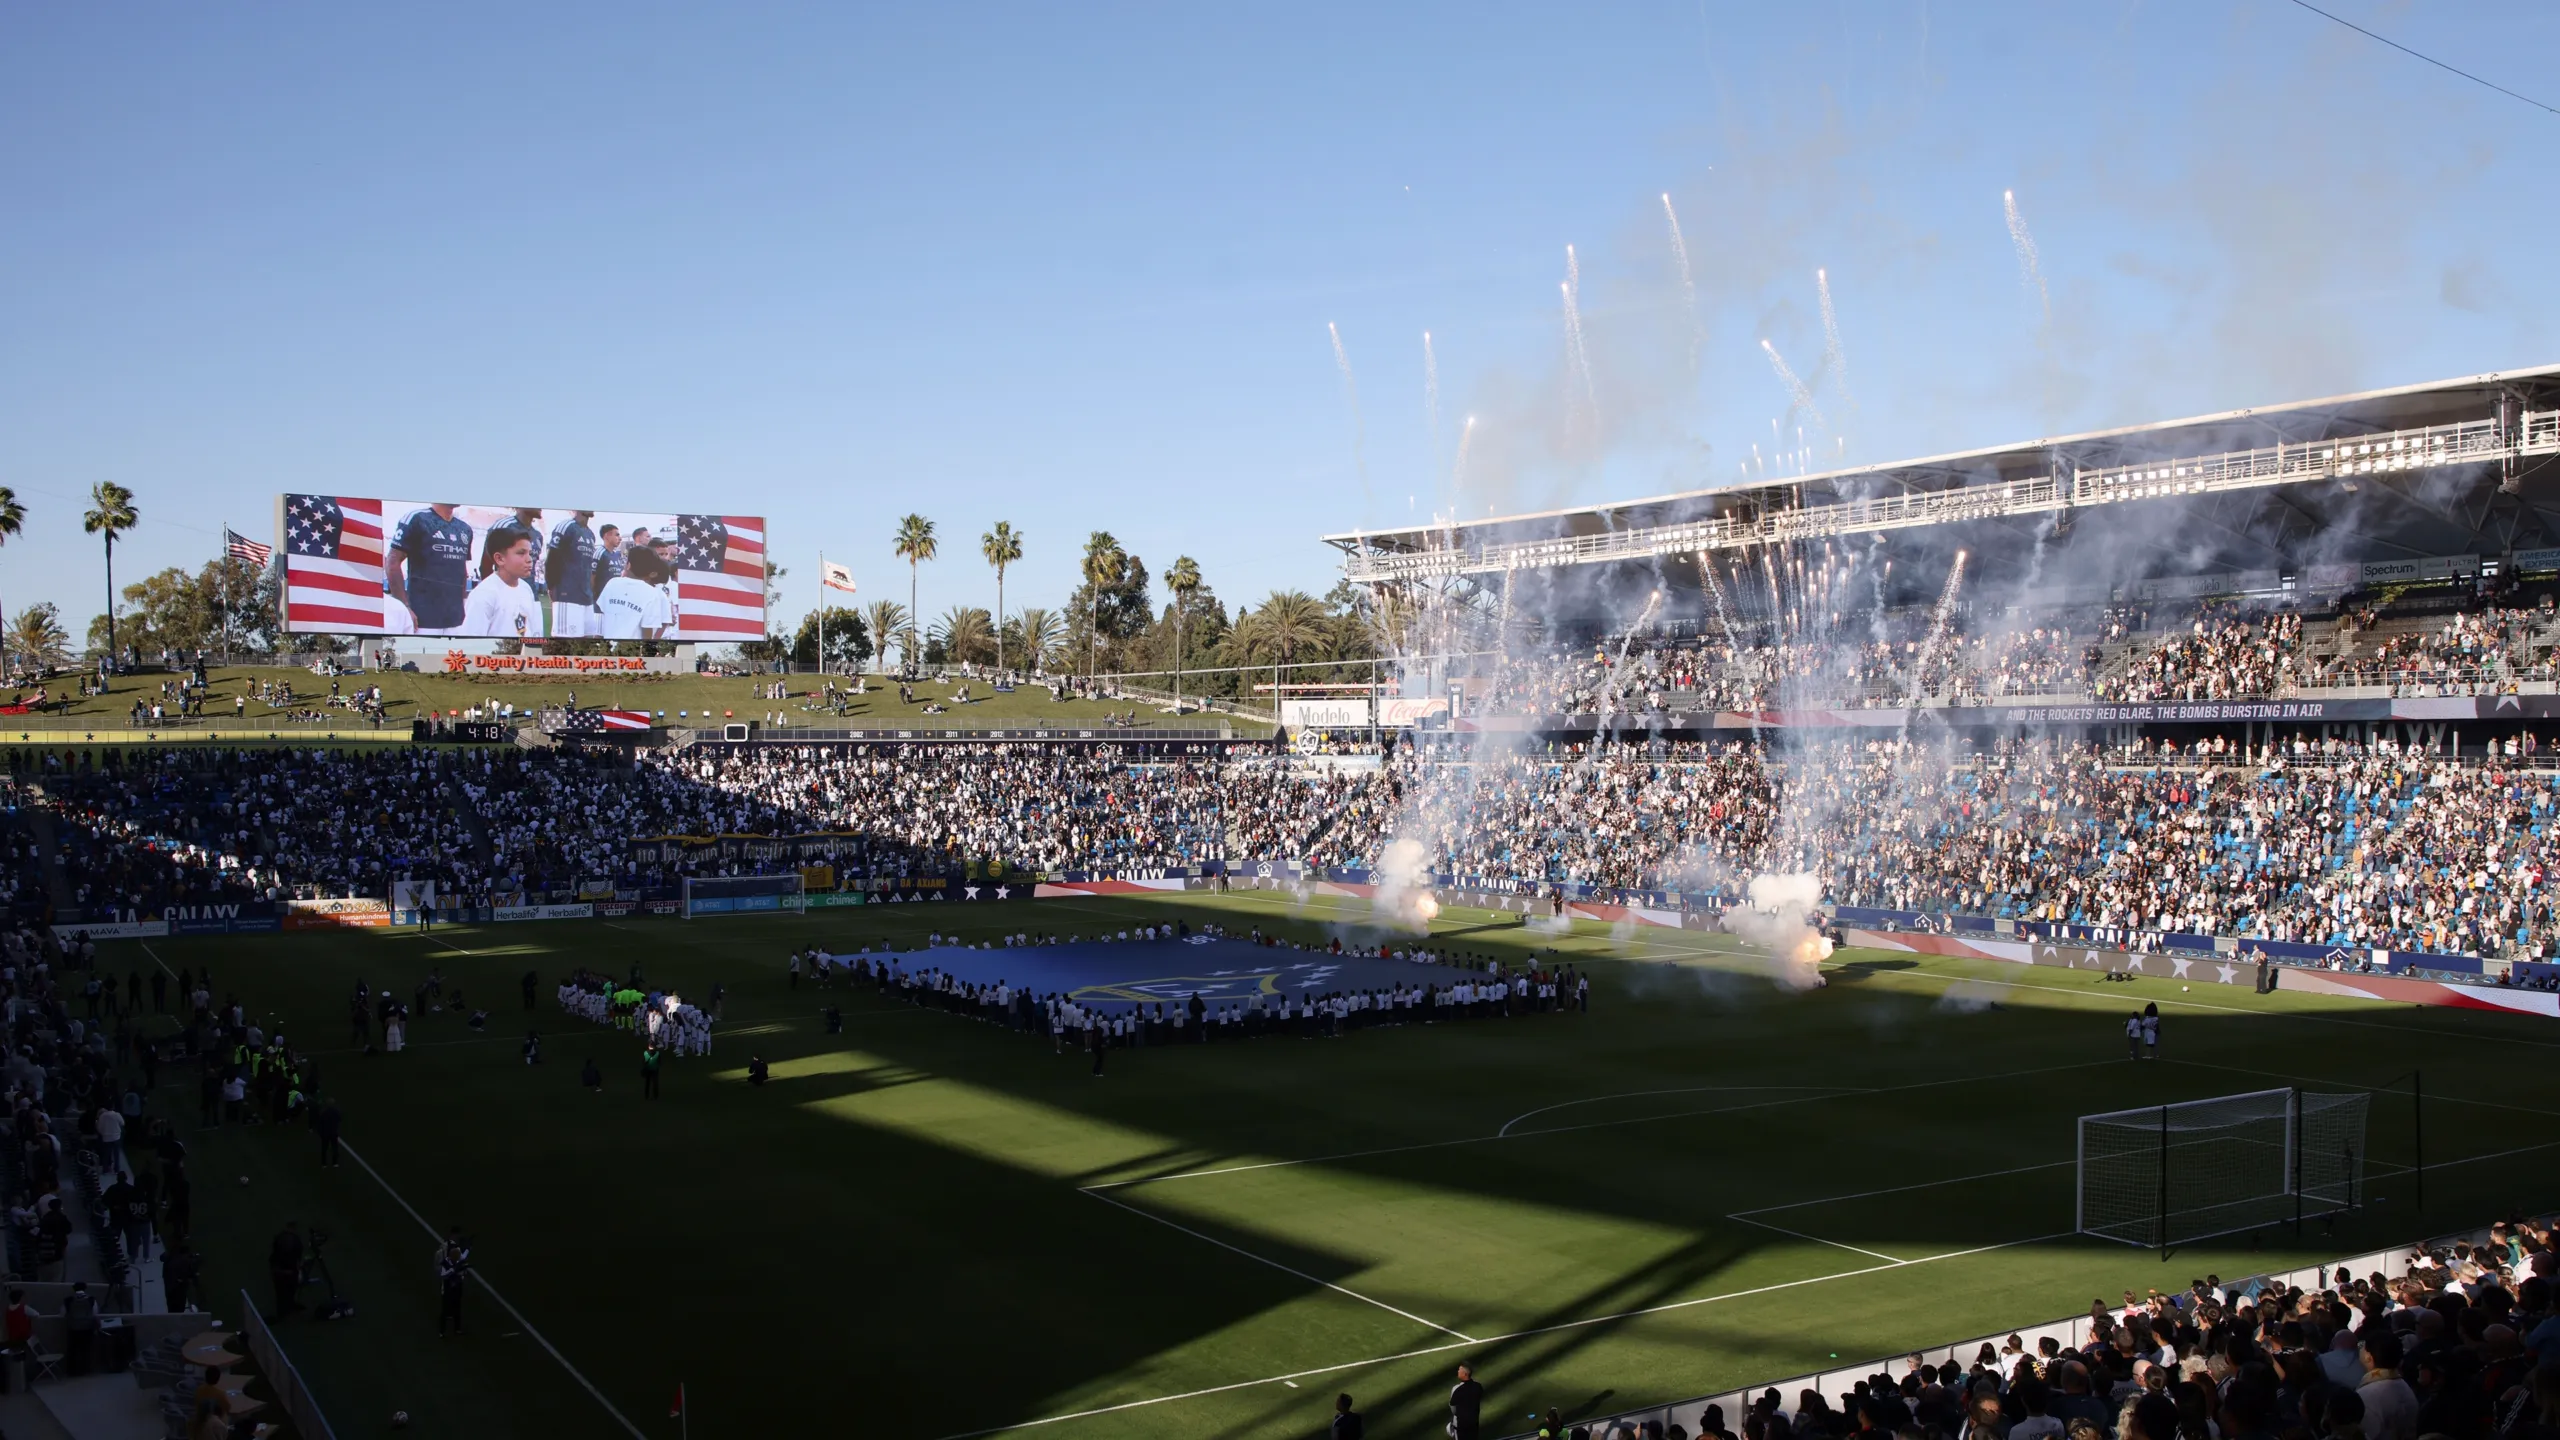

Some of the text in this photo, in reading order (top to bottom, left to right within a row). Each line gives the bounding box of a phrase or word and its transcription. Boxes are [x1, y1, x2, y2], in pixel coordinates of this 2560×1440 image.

[443, 553, 463, 561] AIRWAY
[2452, 558, 2478, 567] ULTRA
[2364, 562, 2414, 578] Spectrum
[2524, 559, 2560, 569] EXPRE
[475, 655, 646, 672] Dignity Health Sports Park
[1298, 706, 1350, 725] Modelo
[1388, 701, 1447, 724] Coca-C
[2007, 703, 2323, 721] AND THE ROCKETS' RED GLARE, THE BOMBS BURSTING IN AIR
[468, 727, 498, 739] 4:18
[1117, 868, 1166, 881] GALAXY
[900, 878, 947, 888] GAAXIANS
[475, 898, 490, 908] LA
[645, 901, 684, 909] DISCOUNT
[782, 896, 814, 907] chime
[826, 894, 857, 905] chime
[163, 904, 240, 921] GALAXY
[548, 906, 586, 918] Herbalife
[595, 902, 636, 911] DISCOUNT
[496, 908, 536, 920] Herbalife
[129, 1202, 147, 1215] 96
